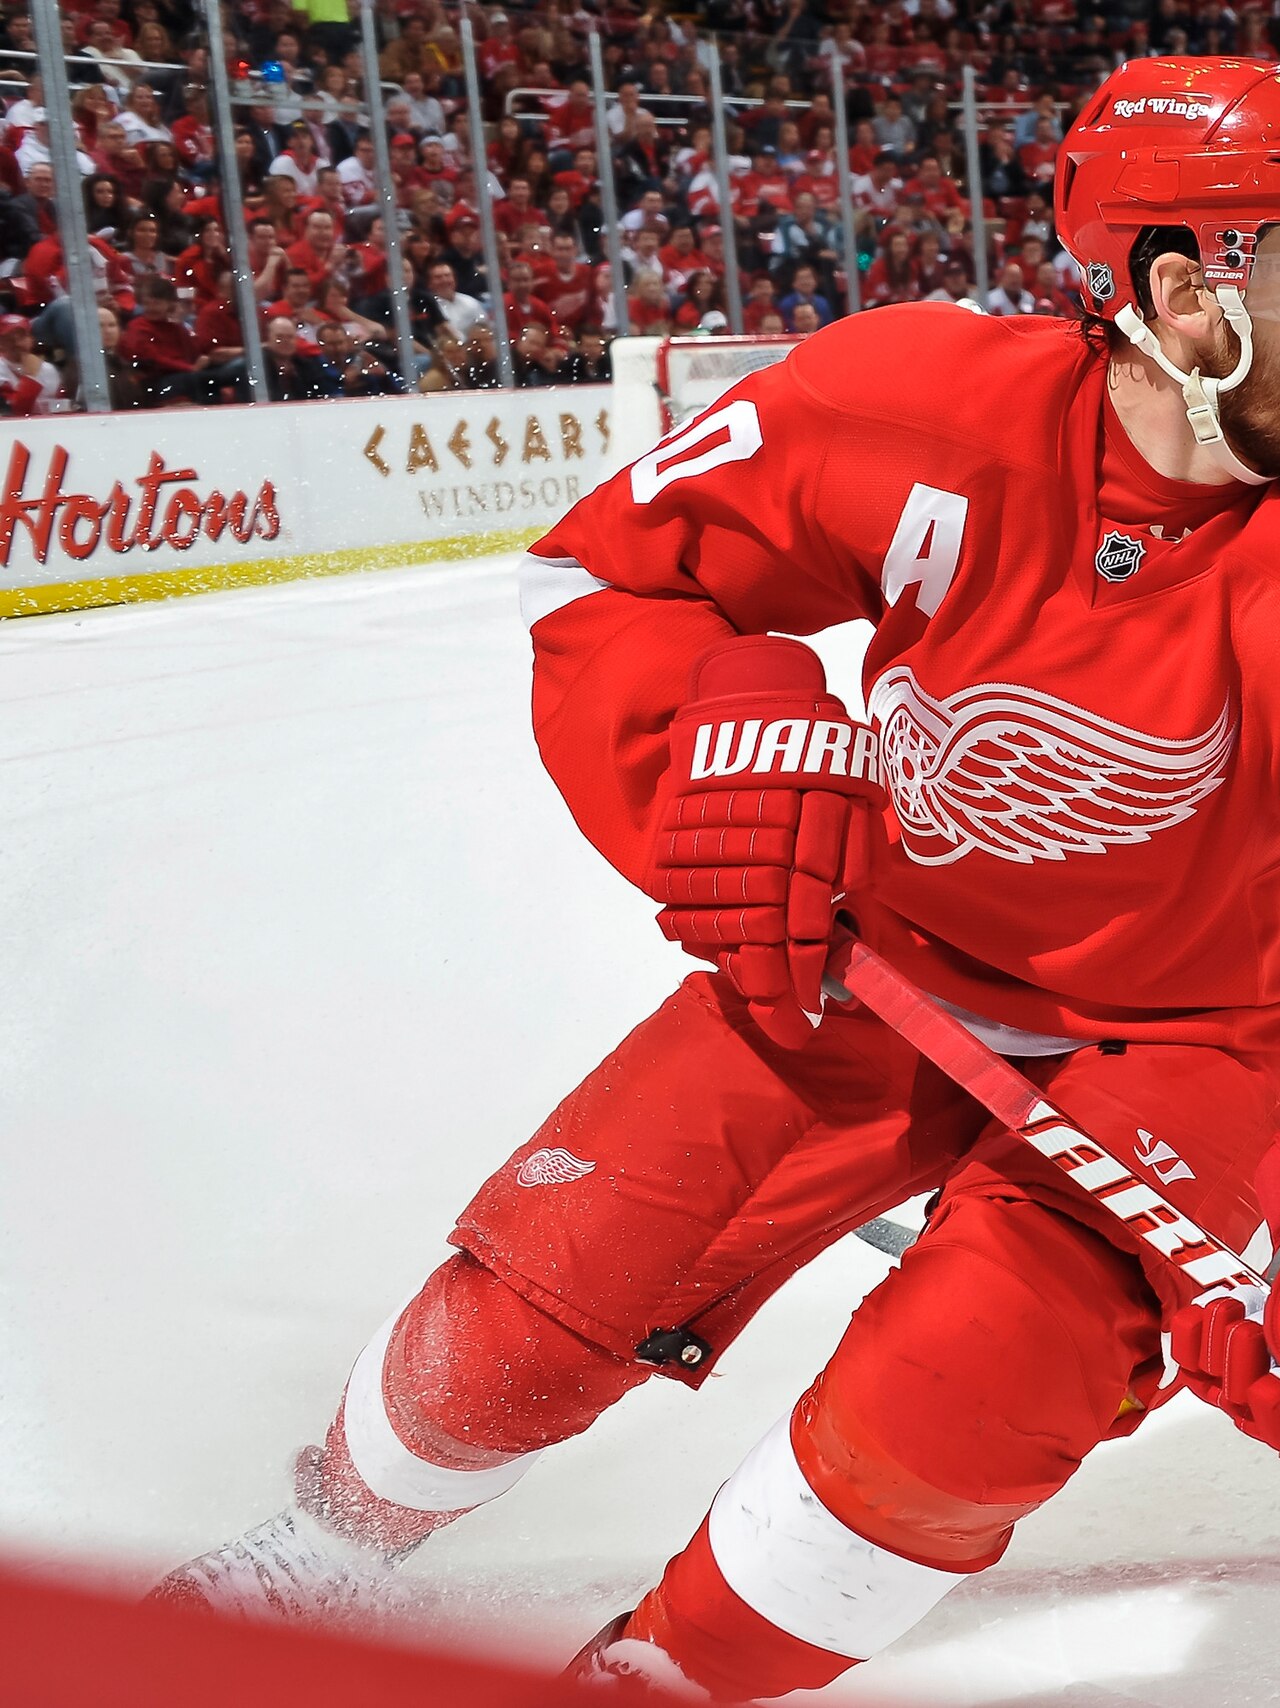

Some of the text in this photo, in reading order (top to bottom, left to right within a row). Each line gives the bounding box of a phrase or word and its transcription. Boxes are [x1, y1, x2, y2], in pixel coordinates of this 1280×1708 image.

[1113, 98, 1210, 120] Red Wings
[364, 408, 612, 477] CAESARS
[630, 399, 764, 504] 0
[0, 439, 281, 567] Hortons
[418, 476, 582, 519] WINDSOR
[881, 481, 968, 619] A
